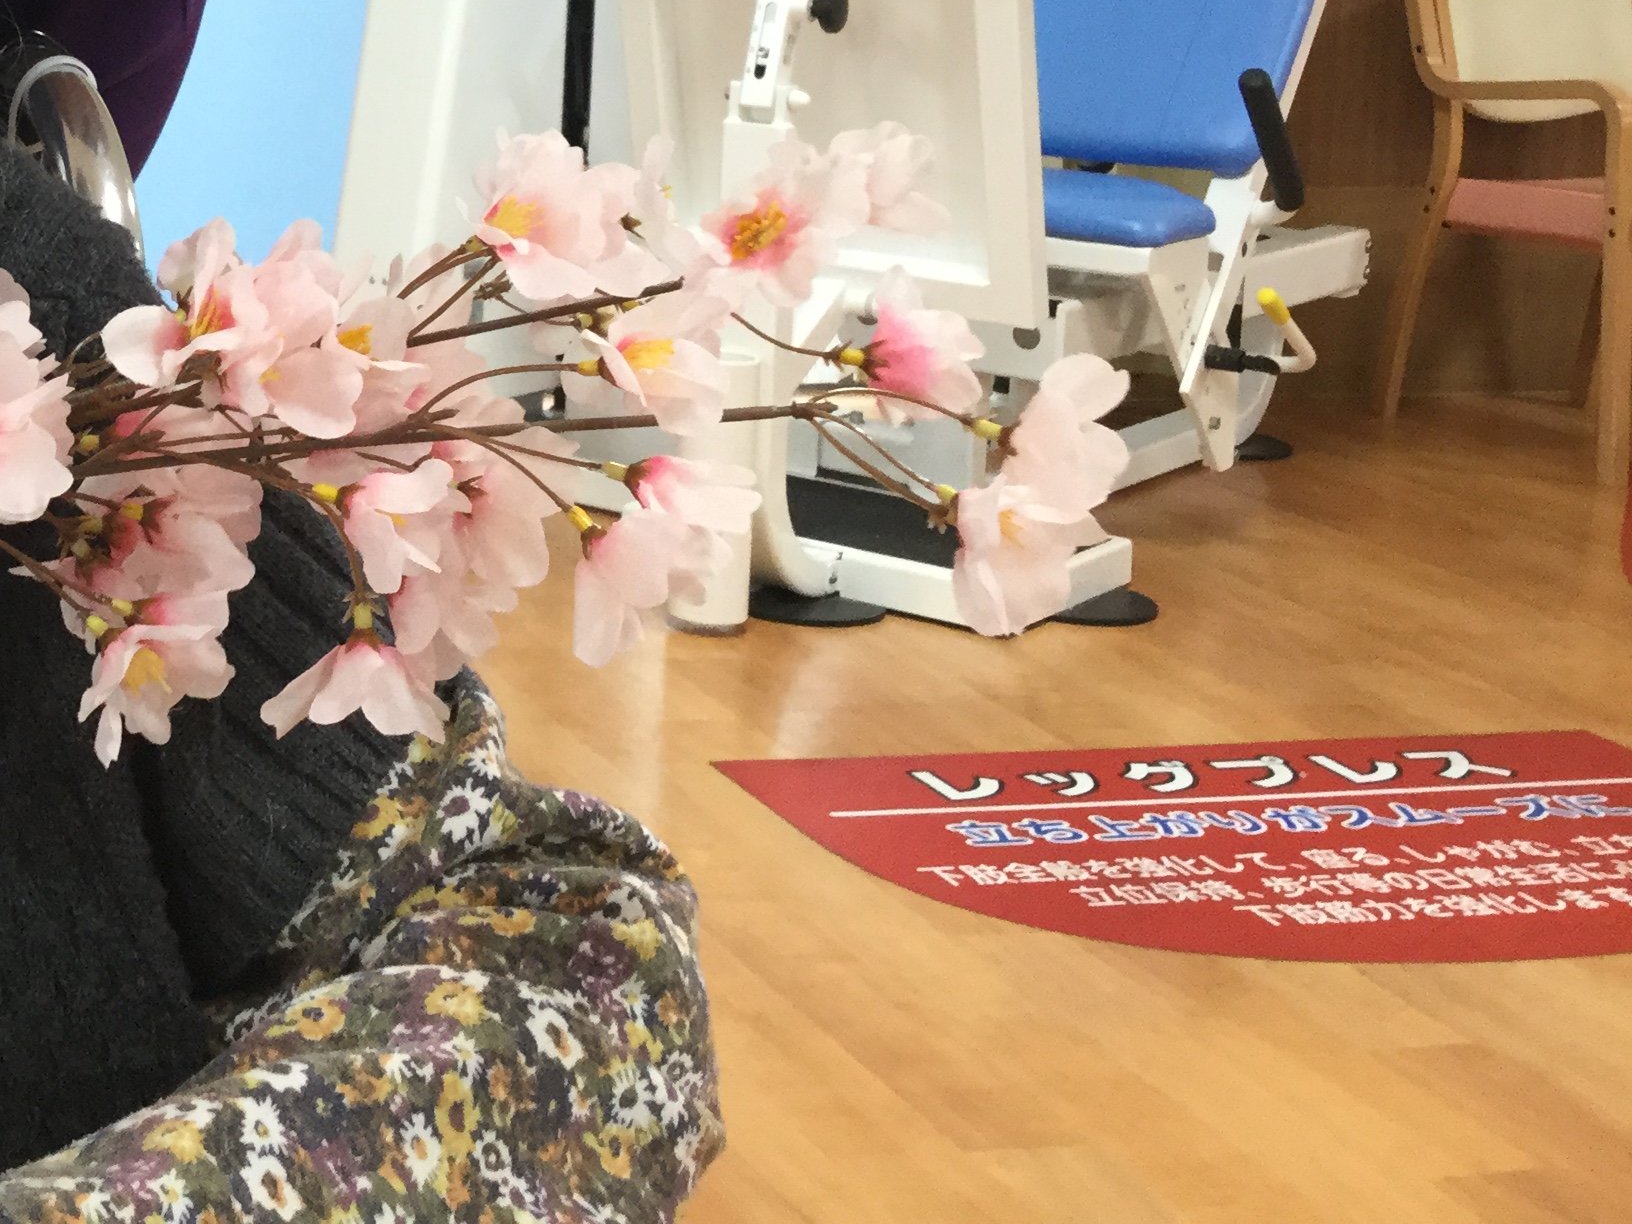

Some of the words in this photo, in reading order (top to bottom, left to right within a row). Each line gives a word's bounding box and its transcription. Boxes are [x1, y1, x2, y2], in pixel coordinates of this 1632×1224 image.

[909, 749, 1516, 801] レッグプレス
